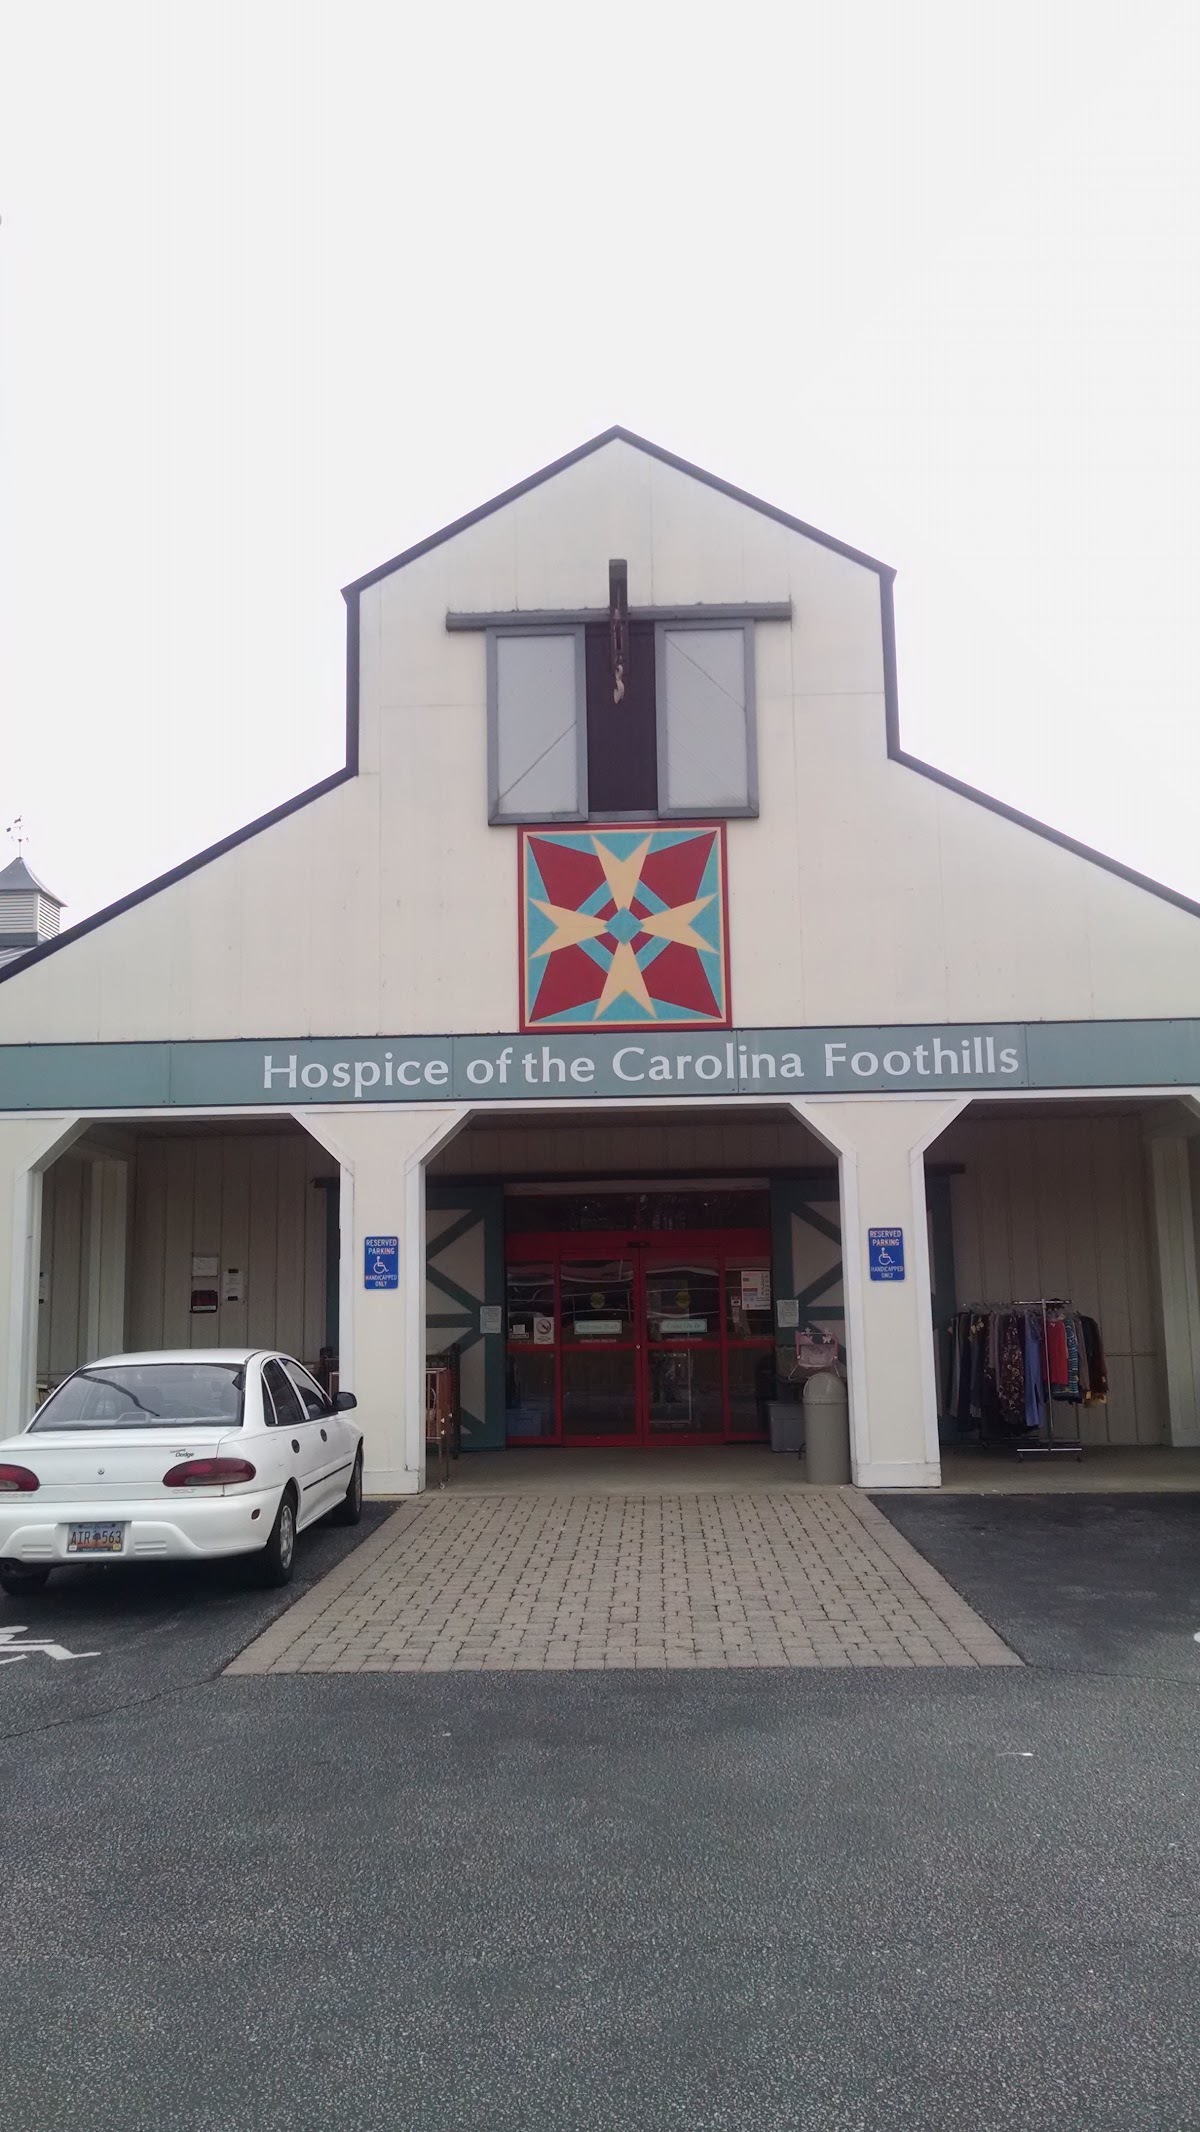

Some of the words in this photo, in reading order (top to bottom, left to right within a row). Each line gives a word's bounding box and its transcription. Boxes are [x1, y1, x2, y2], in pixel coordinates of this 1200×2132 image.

[263, 1051, 449, 1098] Hospice
[466, 1046, 513, 1085] of
[521, 1046, 595, 1083] the
[612, 1042, 805, 1082] Carolina
[824, 1036, 1019, 1077] Foothills
[870, 1230, 901, 1238] RESERVED
[366, 1239, 397, 1247] RESERVED
[368, 1247, 395, 1255] PARKING
[70, 1531, 91, 1545] AIR
[102, 1530, 122, 1544] 563
